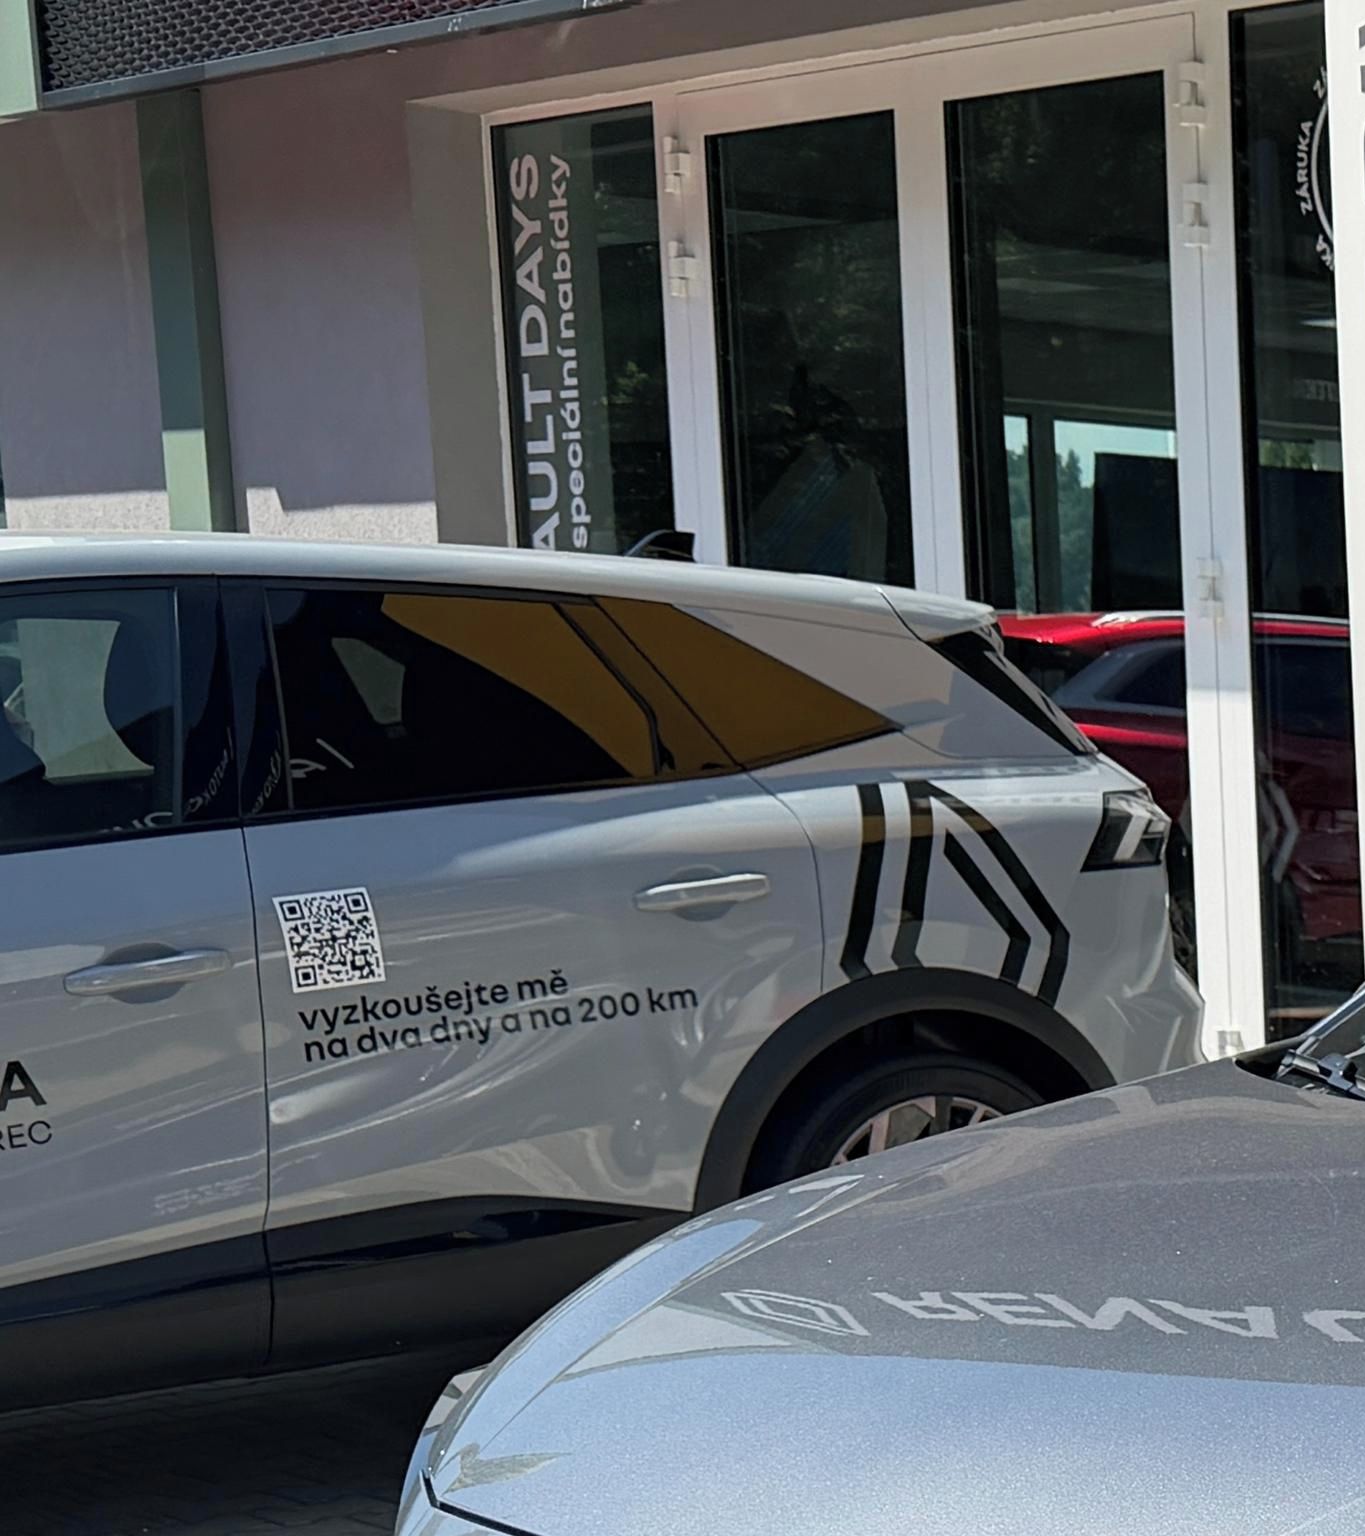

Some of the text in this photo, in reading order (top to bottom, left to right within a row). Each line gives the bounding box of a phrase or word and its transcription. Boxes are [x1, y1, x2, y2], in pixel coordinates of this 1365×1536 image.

[510, 154, 549, 357] DAYS
[548, 154, 591, 549] speciální nabídky
[297, 969, 569, 1035] vyzkoušejte mě
[303, 987, 700, 1063] na dva dny a na 200 km
